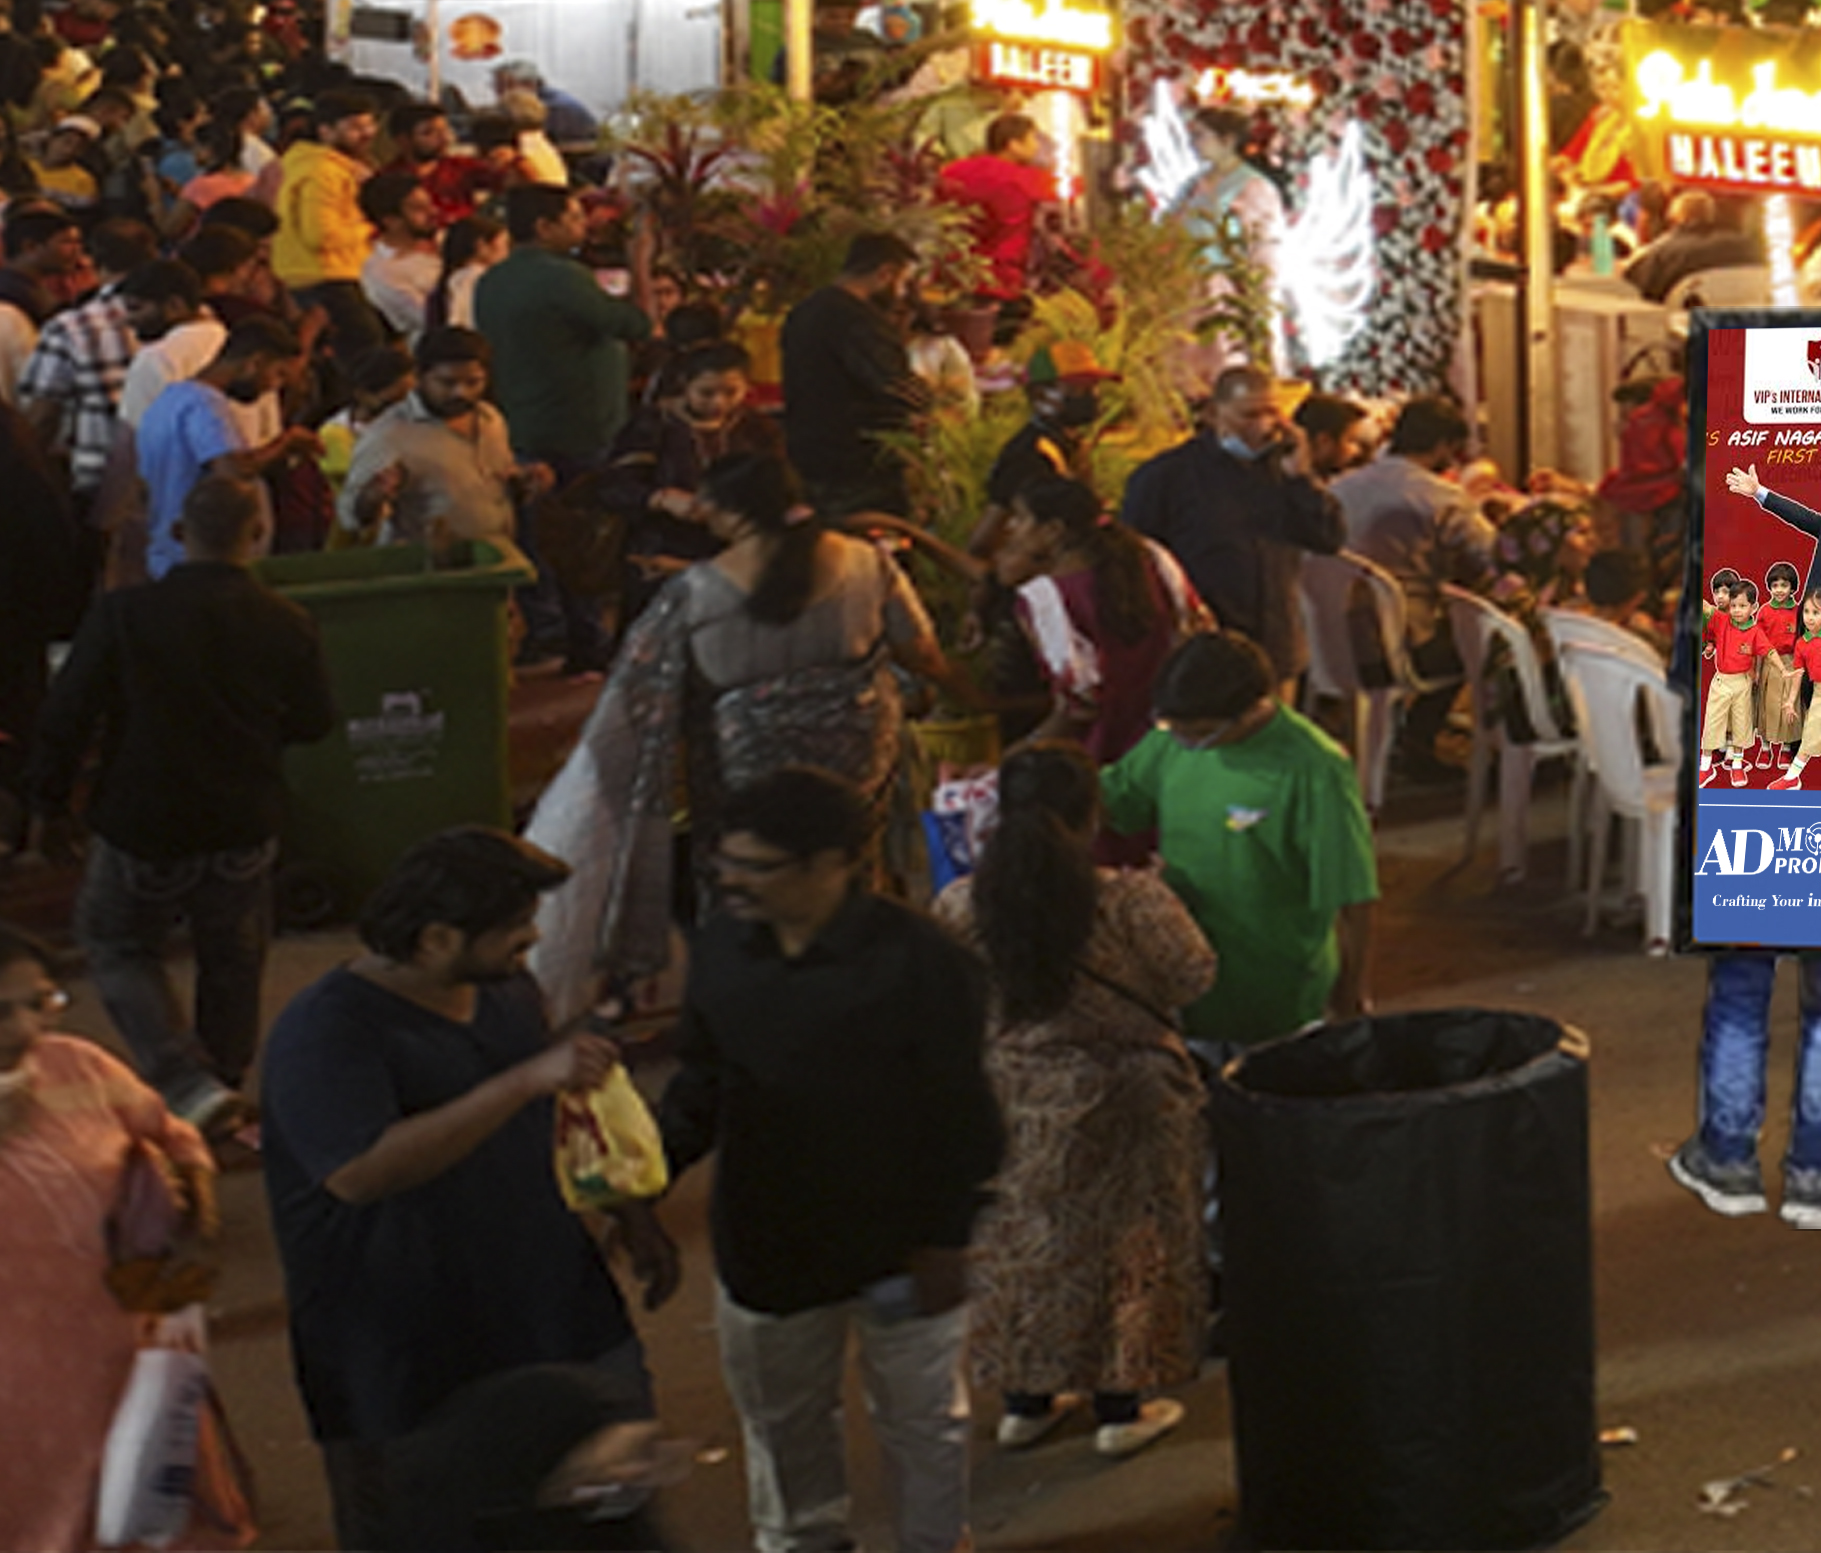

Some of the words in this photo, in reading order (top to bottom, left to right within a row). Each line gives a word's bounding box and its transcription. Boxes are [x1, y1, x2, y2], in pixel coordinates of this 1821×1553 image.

[1754, 391, 1778, 404] VIP's
[1771, 406, 1784, 415] WE
[1785, 406, 1809, 415] WORK
[1727, 430, 1769, 446] ASIF
[1767, 449, 1818, 464] FIRST
[1712, 894, 1767, 910] Crafting
[1772, 894, 1803, 907] Your
